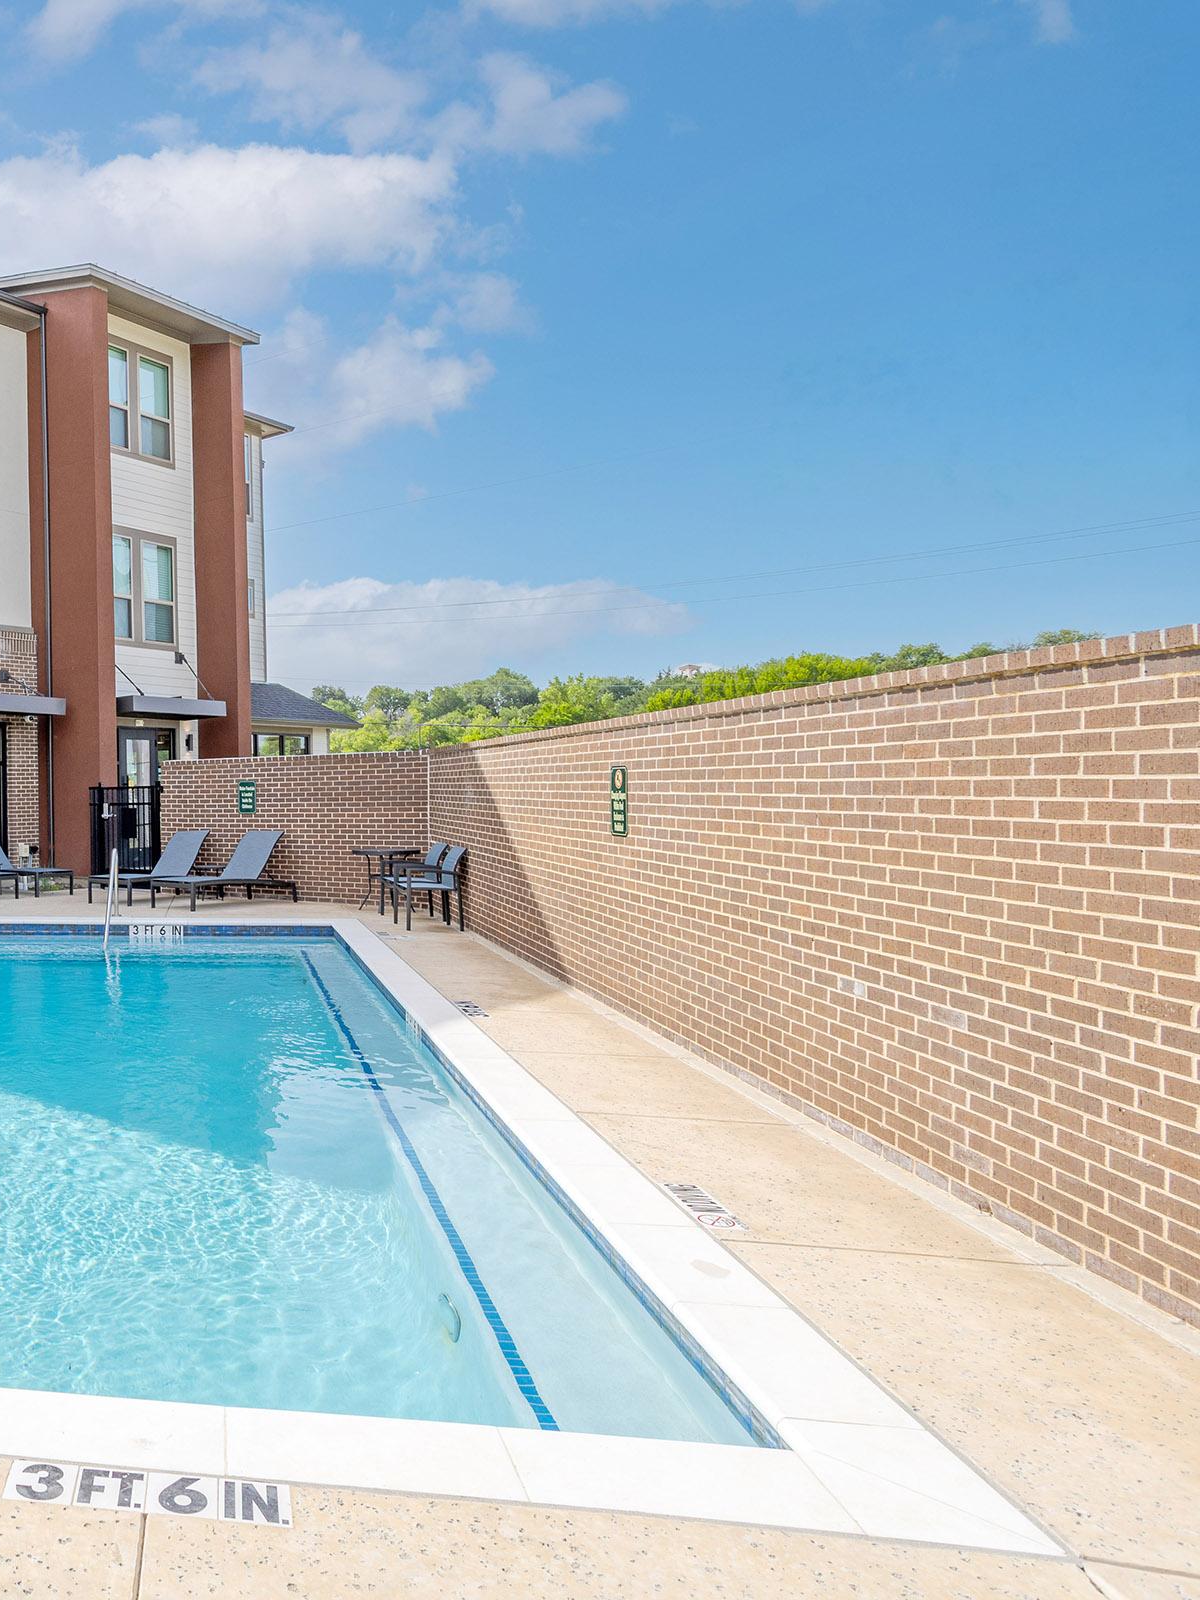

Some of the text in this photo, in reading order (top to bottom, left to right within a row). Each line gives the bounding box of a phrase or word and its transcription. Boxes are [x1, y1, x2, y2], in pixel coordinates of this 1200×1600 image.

[132, 925, 181, 936] 3 FT 6 IN
[15, 1463, 65, 1501] 3
[76, 1468, 144, 1508] FT.
[158, 1476, 208, 1515] 6
